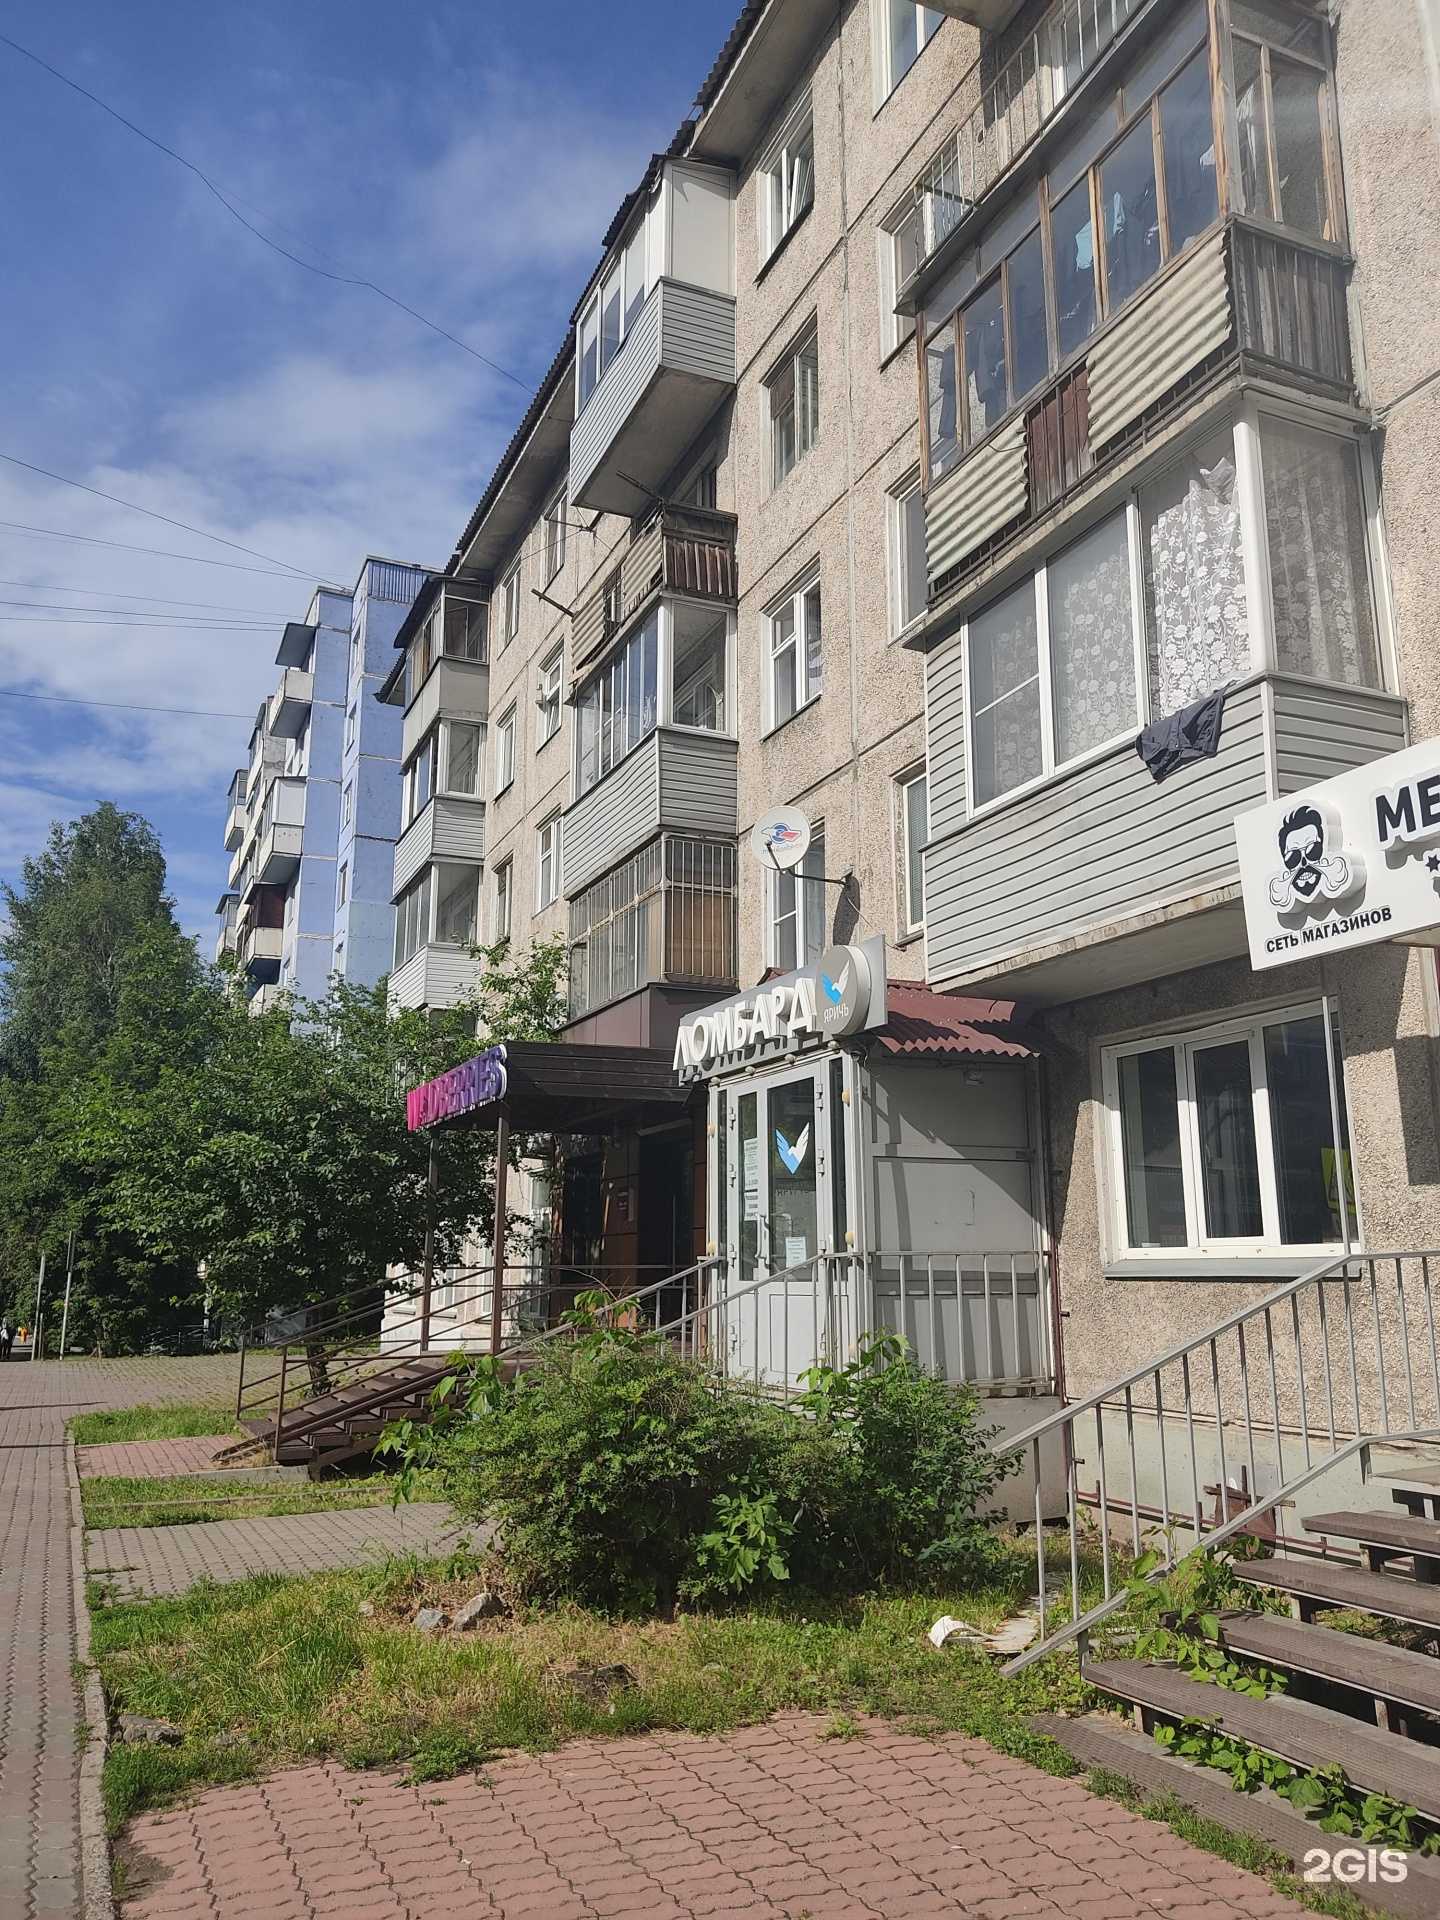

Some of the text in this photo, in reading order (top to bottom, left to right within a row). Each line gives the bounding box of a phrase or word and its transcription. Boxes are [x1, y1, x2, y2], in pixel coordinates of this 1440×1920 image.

[1266, 907, 1392, 953] СЕТЬ МАГАЗИНОВ
[673, 977, 817, 1071] ЛОМБАРД
